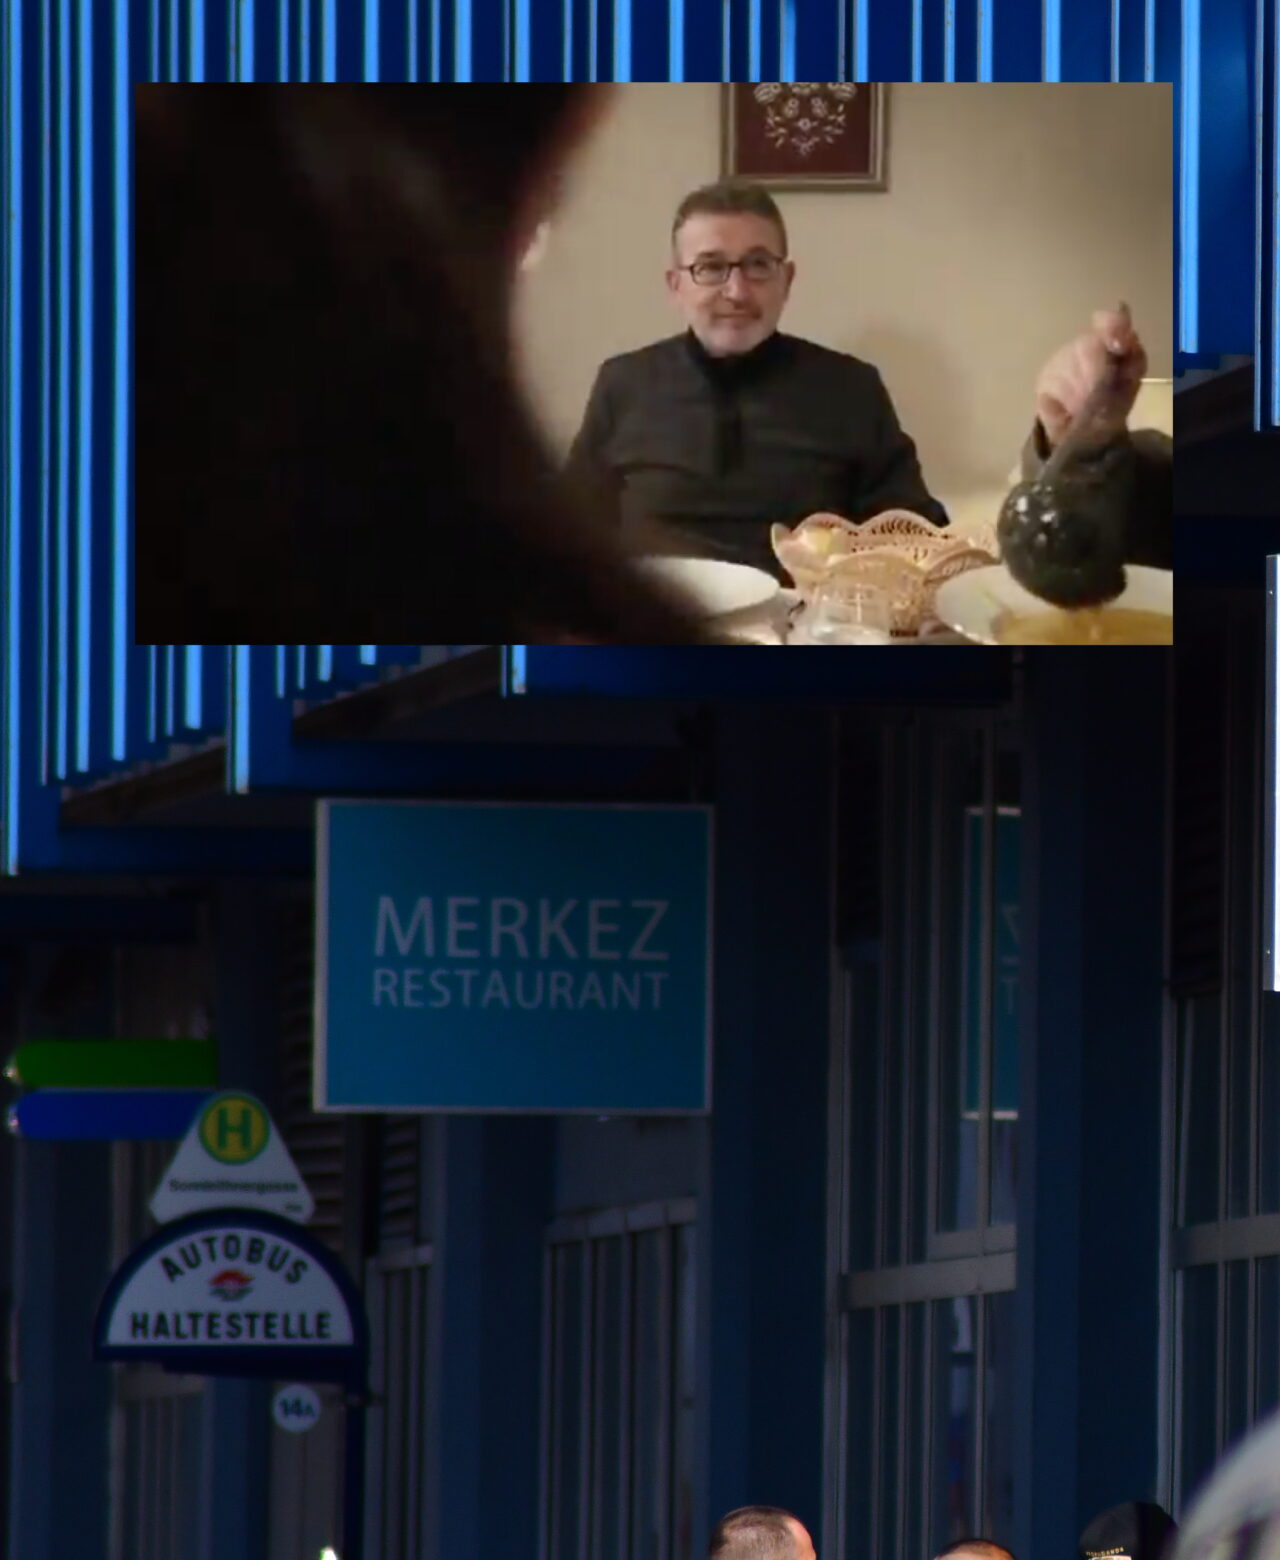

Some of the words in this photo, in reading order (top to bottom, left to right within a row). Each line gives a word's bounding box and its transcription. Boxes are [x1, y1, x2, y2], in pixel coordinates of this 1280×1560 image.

[373, 896, 669, 962] MERKEZ
[372, 969, 669, 1010] RESTAURANT
[217, 1108, 252, 1150] H
[161, 1235, 308, 1284] AUTOBUS
[131, 1311, 332, 1339] HALTESTELLE
